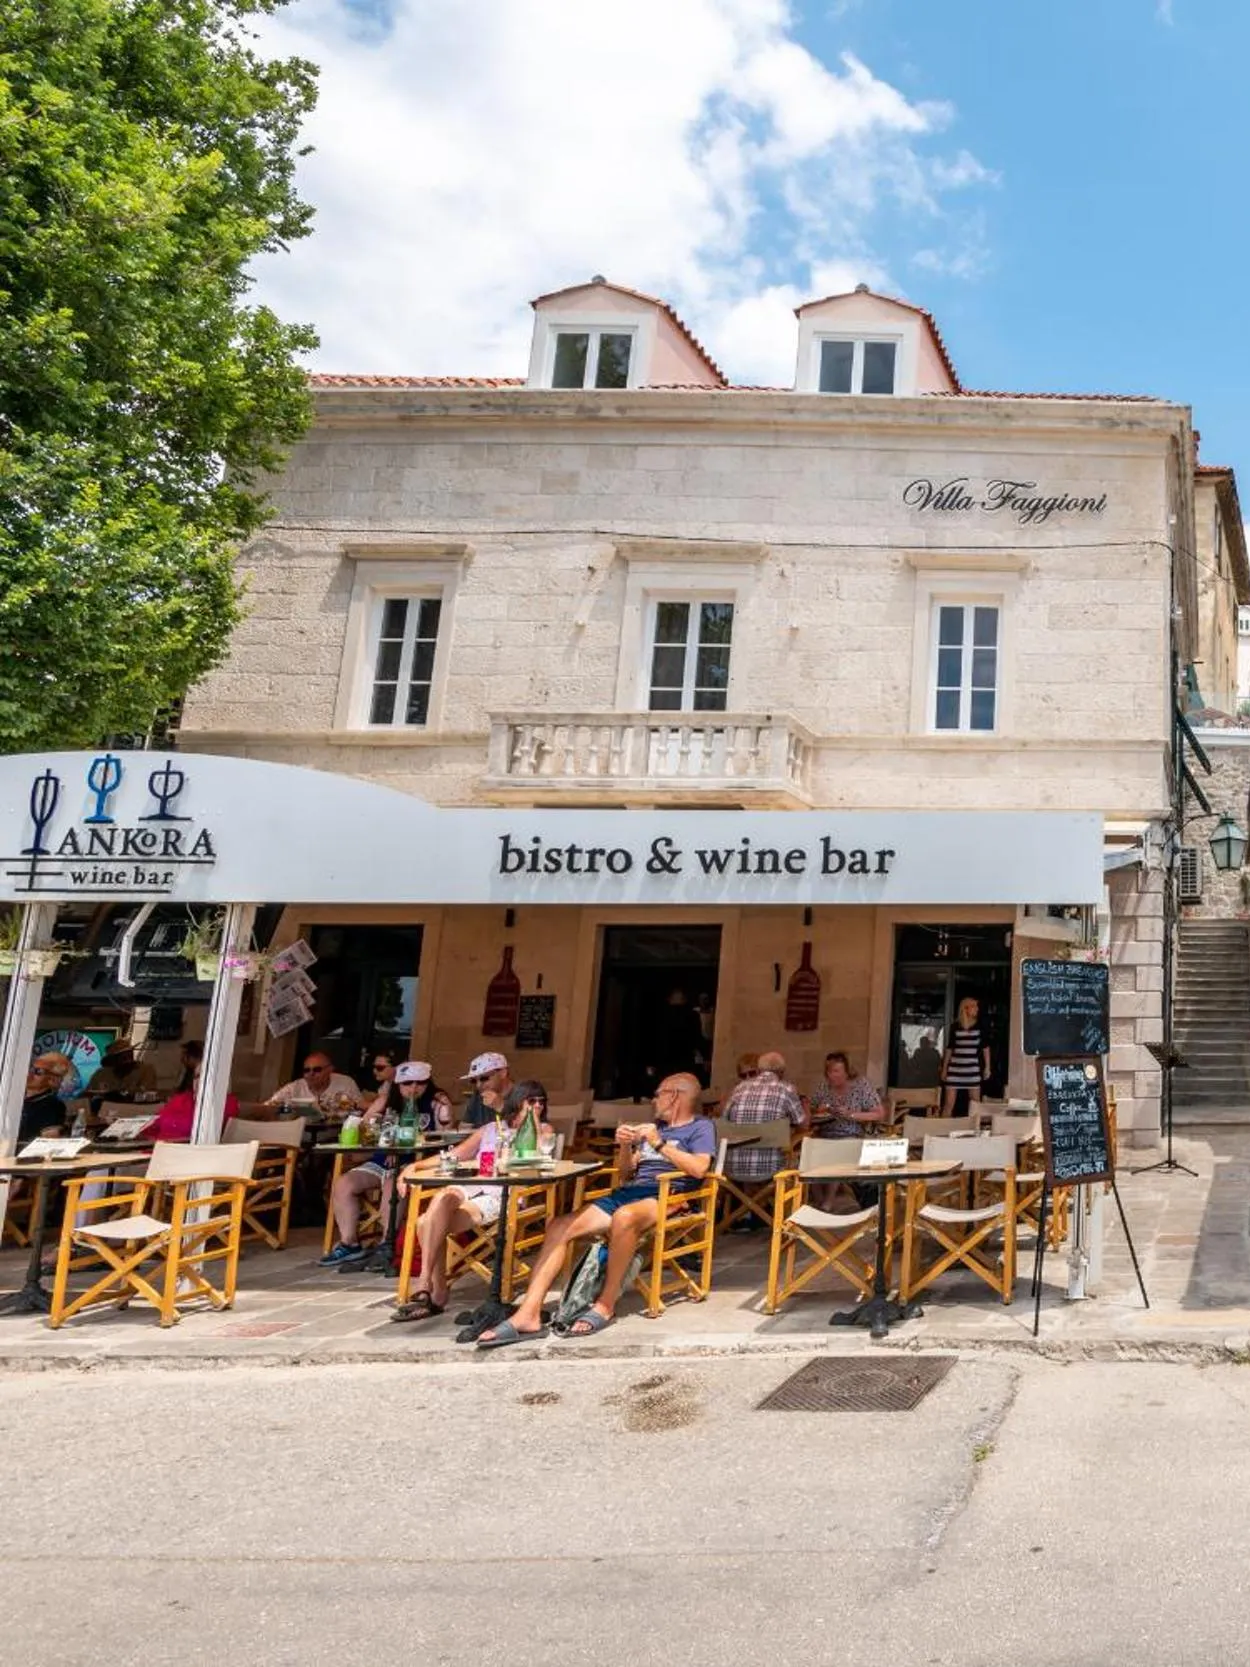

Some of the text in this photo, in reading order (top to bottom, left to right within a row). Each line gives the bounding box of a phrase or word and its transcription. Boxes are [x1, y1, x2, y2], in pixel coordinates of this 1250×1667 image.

[902, 477, 1108, 525] Villa Faggioni
[497, 834, 896, 875] bistro & wine bar
[69, 866, 174, 885] wine bar
